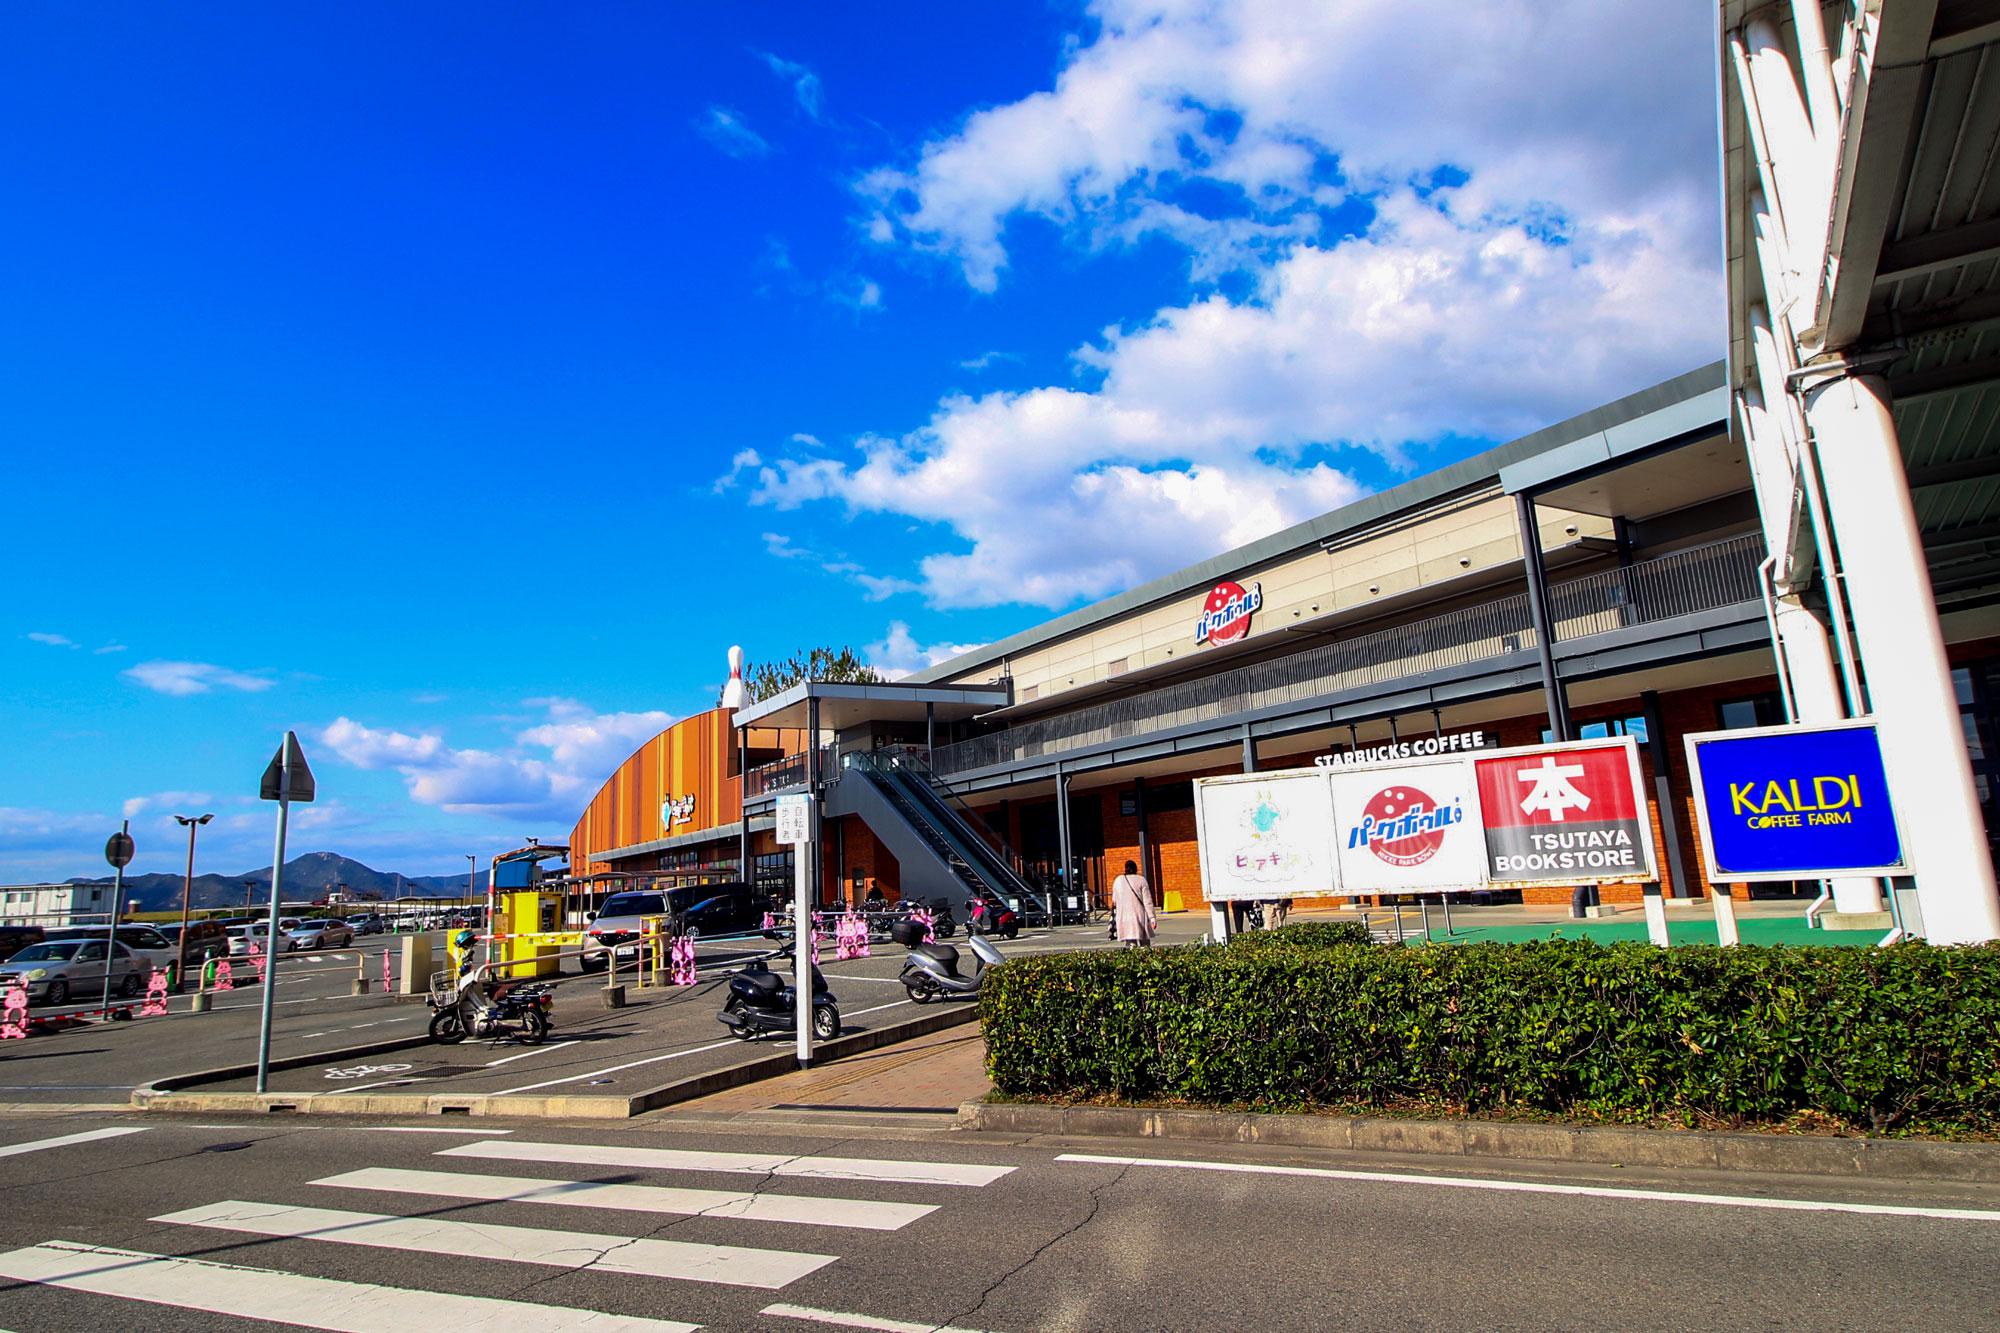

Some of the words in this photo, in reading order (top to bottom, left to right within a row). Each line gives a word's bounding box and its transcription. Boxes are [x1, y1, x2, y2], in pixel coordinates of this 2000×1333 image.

[1314, 741, 1410, 768] STARBUCKS
[1412, 731, 1485, 756] COFFEE
[1517, 756, 1591, 821] 本
[1729, 774, 1862, 815] KALDI
[1747, 813, 1802, 829] COFFEE
[1808, 811, 1852, 826] FARM
[1531, 829, 1632, 850] TSUTAYA
[1495, 849, 1636, 872] BOOKSTORE
